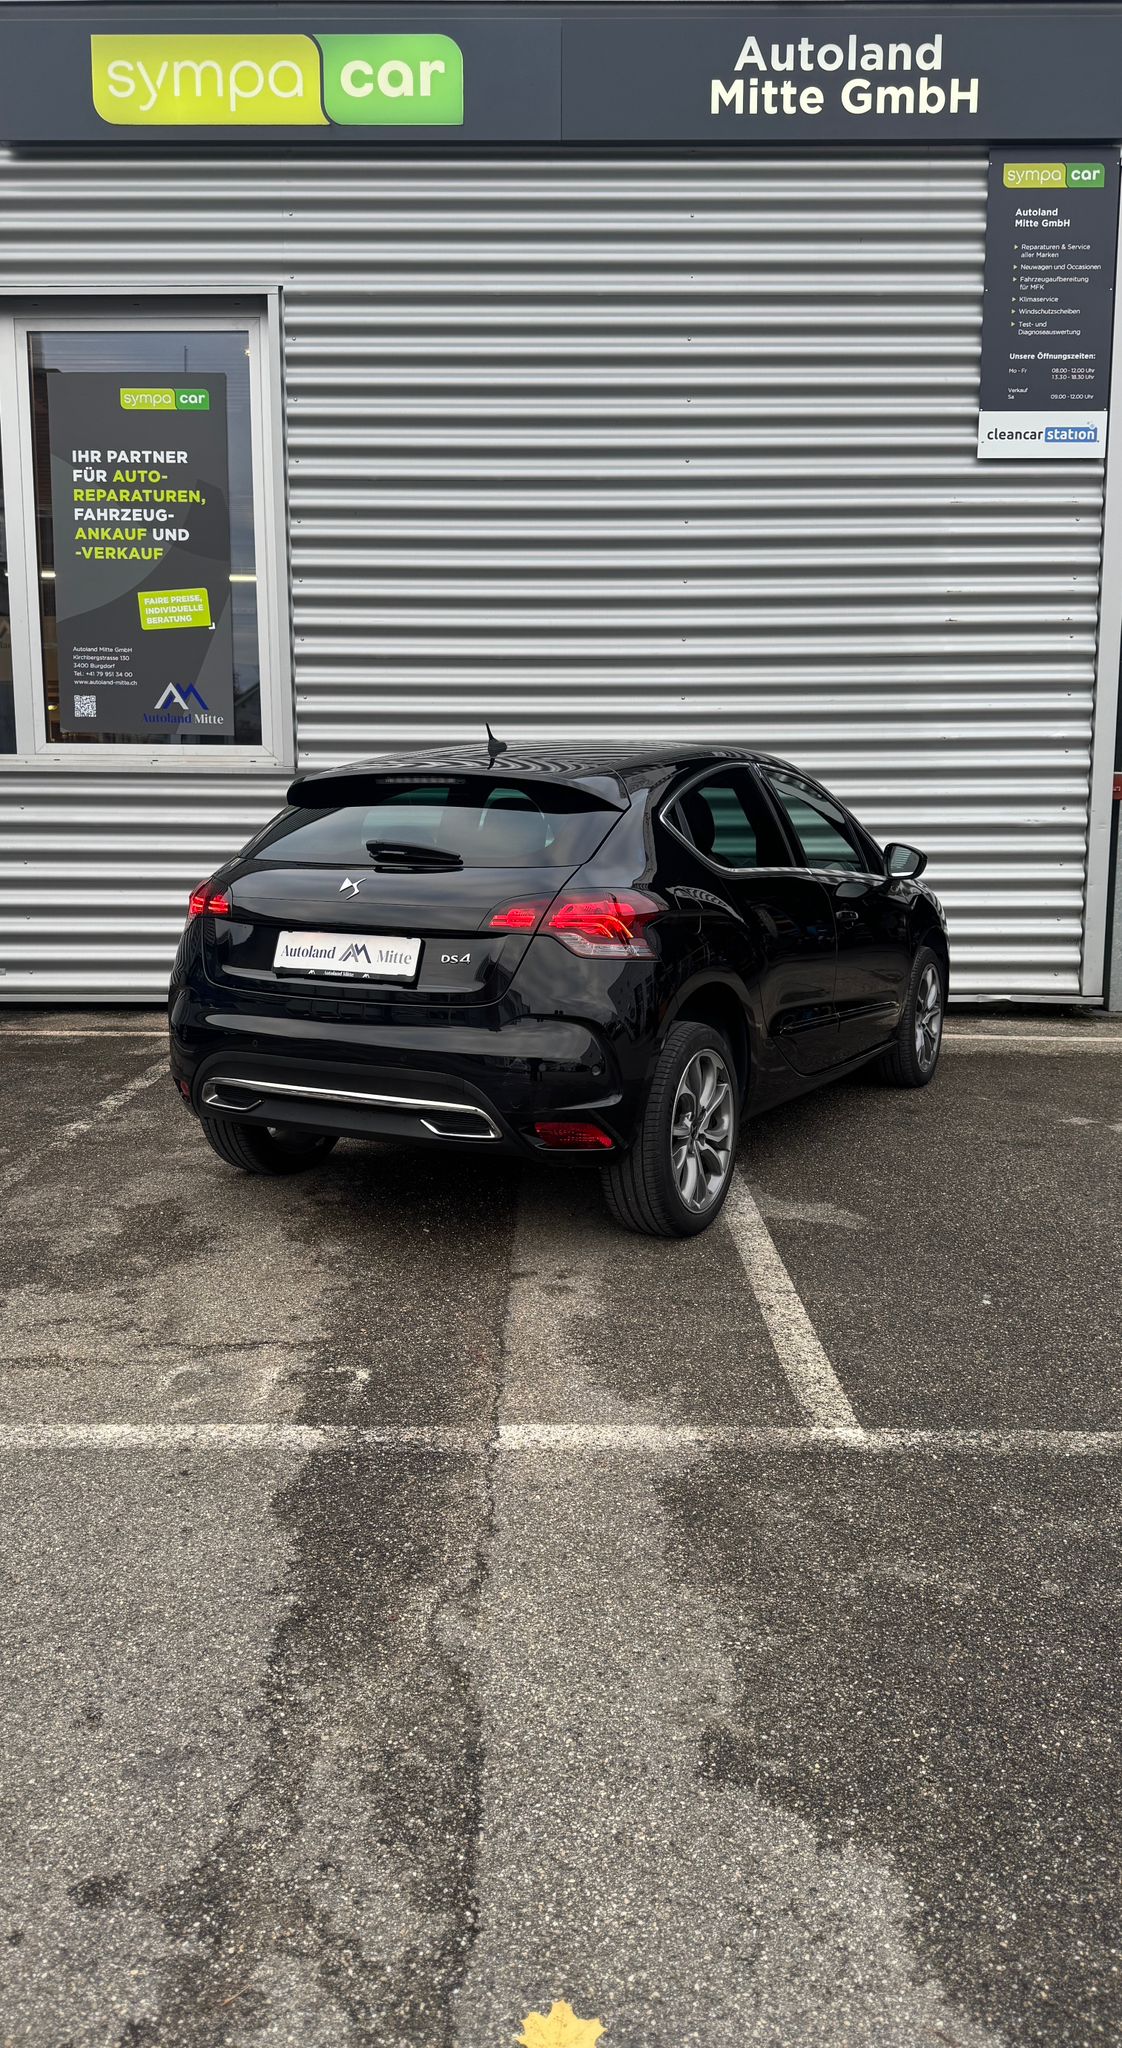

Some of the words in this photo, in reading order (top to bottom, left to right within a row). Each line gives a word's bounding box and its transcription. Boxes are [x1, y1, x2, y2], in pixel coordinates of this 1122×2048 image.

[733, 34, 943, 71] Autoland
[107, 60, 303, 112] sympa
[340, 60, 446, 98] car
[710, 77, 825, 115] Mitte
[841, 77, 979, 115] GmbH
[1007, 170, 1062, 184] sympa
[1071, 169, 1100, 180] car
[1015, 208, 1058, 217] Autoland
[1015, 219, 1039, 228] Mitte
[1041, 219, 1071, 228] GmbH
[1021, 243, 1060, 252] Reparaturen
[1018, 328, 1081, 336] Diagnoseauswertung
[1037, 352, 1096, 361] Öffnungszeiten:
[123, 394, 172, 406] sympa
[179, 394, 206, 404] car
[987, 428, 1043, 440] cleancar
[1047, 429, 1095, 440] station
[72, 450, 102, 463] IHR
[107, 450, 188, 464] PARTNER
[72, 466, 107, 482] FÜR
[112, 470, 168, 482] AUTO-
[73, 488, 206, 505] REPARATUREN,
[74, 508, 175, 521] FAHRZEUG-
[75, 527, 147, 540] ANKAUF
[152, 528, 190, 541] UND
[75, 546, 164, 560] -VERKAUF
[144, 596, 169, 605] FAIRE
[170, 594, 203, 604] PREISE,
[145, 604, 204, 615] INDIVIDUELLE
[146, 614, 193, 625] BERATUNG
[90, 662, 116, 670] Burgdorf
[143, 713, 192, 724] Autoland
[194, 713, 224, 724] Mitte
[280, 944, 336, 959] Autoland
[376, 949, 412, 964] Mitte
[440, 953, 471, 964] DS4
